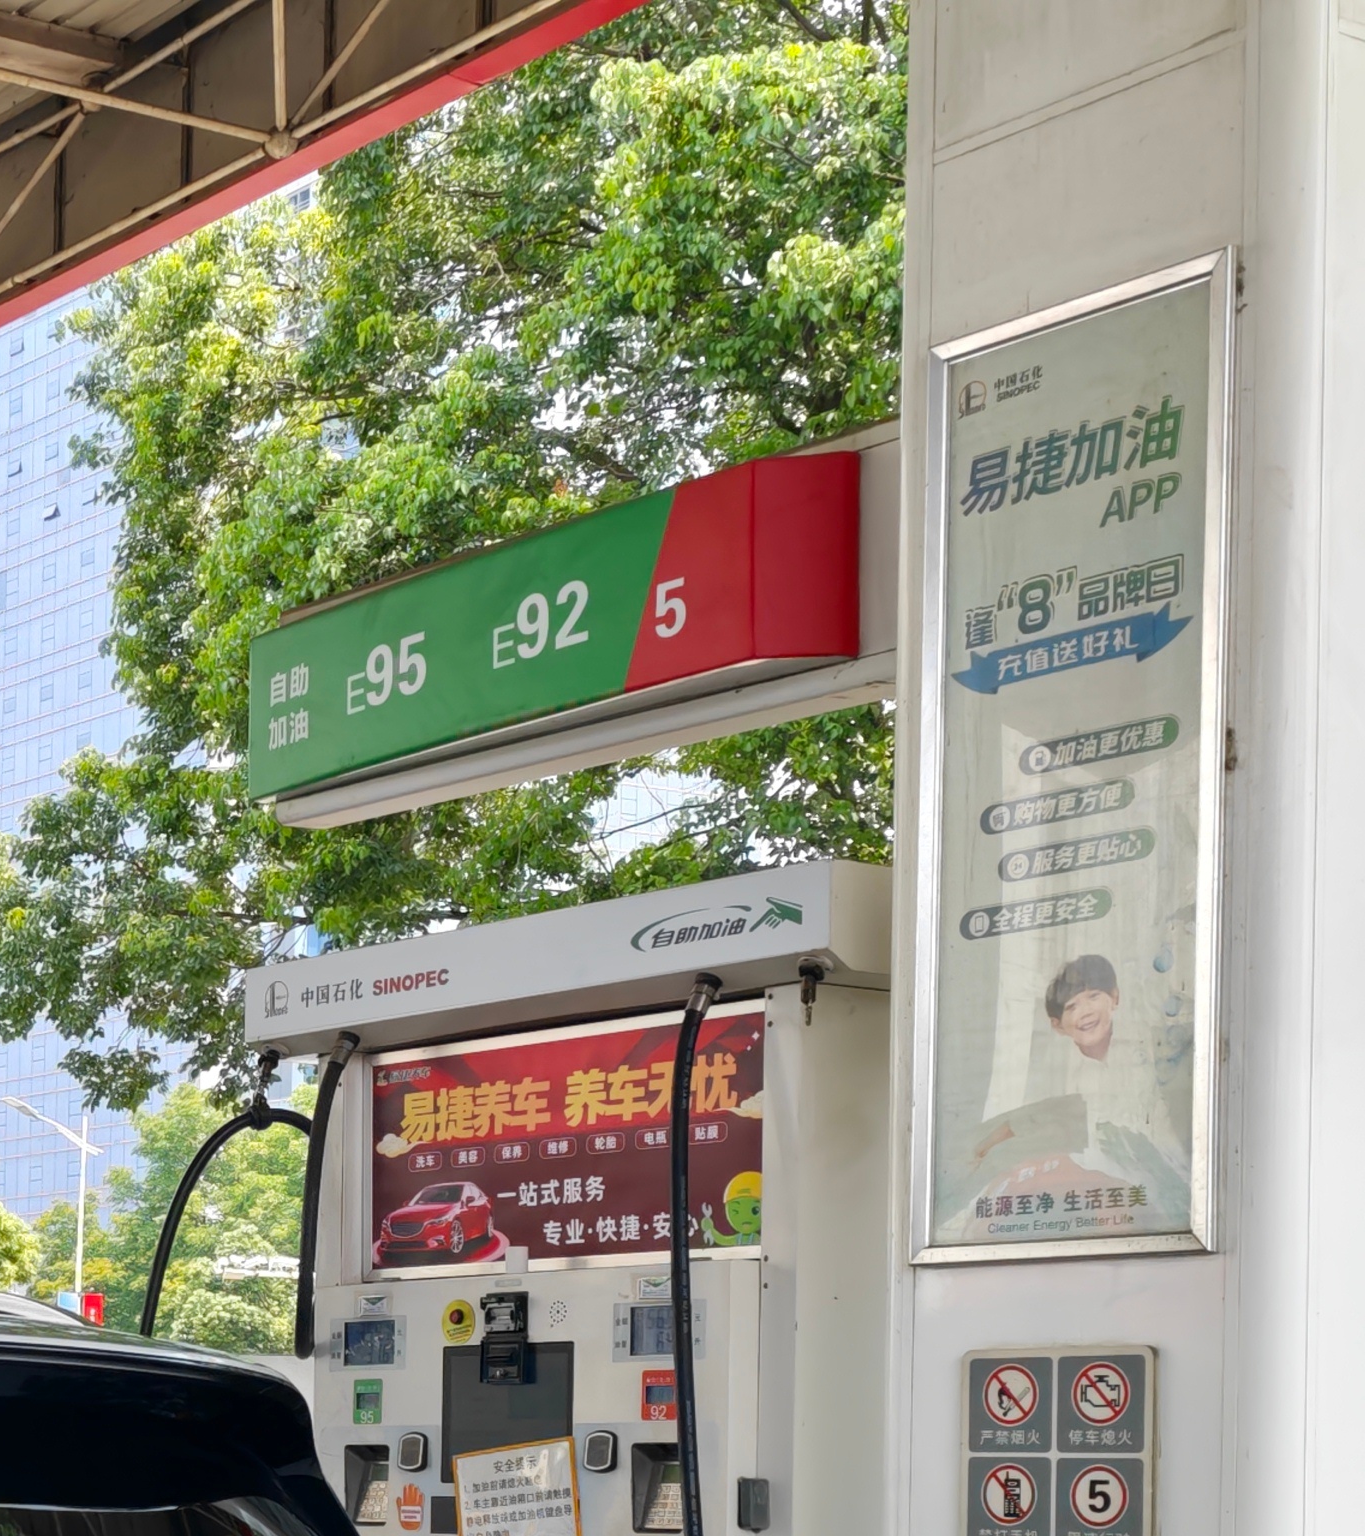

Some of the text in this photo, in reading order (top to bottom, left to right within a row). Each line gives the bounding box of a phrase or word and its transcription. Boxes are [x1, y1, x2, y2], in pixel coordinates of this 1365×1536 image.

[994, 364, 1043, 392] 中国石化
[996, 380, 1041, 403] SINOPEC
[960, 395, 1186, 517] 易捷加油
[1099, 472, 1183, 528] APP
[492, 580, 589, 670] E92
[654, 577, 687, 639] 5
[346, 631, 427, 716] E95
[997, 626, 1139, 682] 充值送好礼
[269, 662, 309, 706] 自助
[269, 707, 310, 751] 加油
[1053, 719, 1167, 766] 加油更优惠
[1012, 781, 1123, 825] 购物更方便
[1031, 831, 1142, 875] 服务更贴心
[651, 917, 747, 949] 自助加油
[990, 892, 1099, 934] 全程更安全
[301, 968, 450, 1008] 中国石化 SINOPEC
[400, 1077, 551, 1144] 易捷养车
[501, 1145, 522, 1160] 保养
[547, 1140, 569, 1156] 维修
[594, 1135, 617, 1150] 轮胎
[694, 1126, 719, 1141] 贴膜
[497, 1176, 606, 1207] 一站式服务
[975, 1185, 1148, 1219] 能源至净 生活至美
[987, 1213, 1135, 1234] Cleaner Energy Better Life
[360, 1410, 374, 1424] 95
[650, 1405, 667, 1420] 92
[980, 1429, 1041, 1446] 严禁烟火
[1068, 1429, 1133, 1446] 停车熄火
[1088, 1480, 1111, 1513] 5
